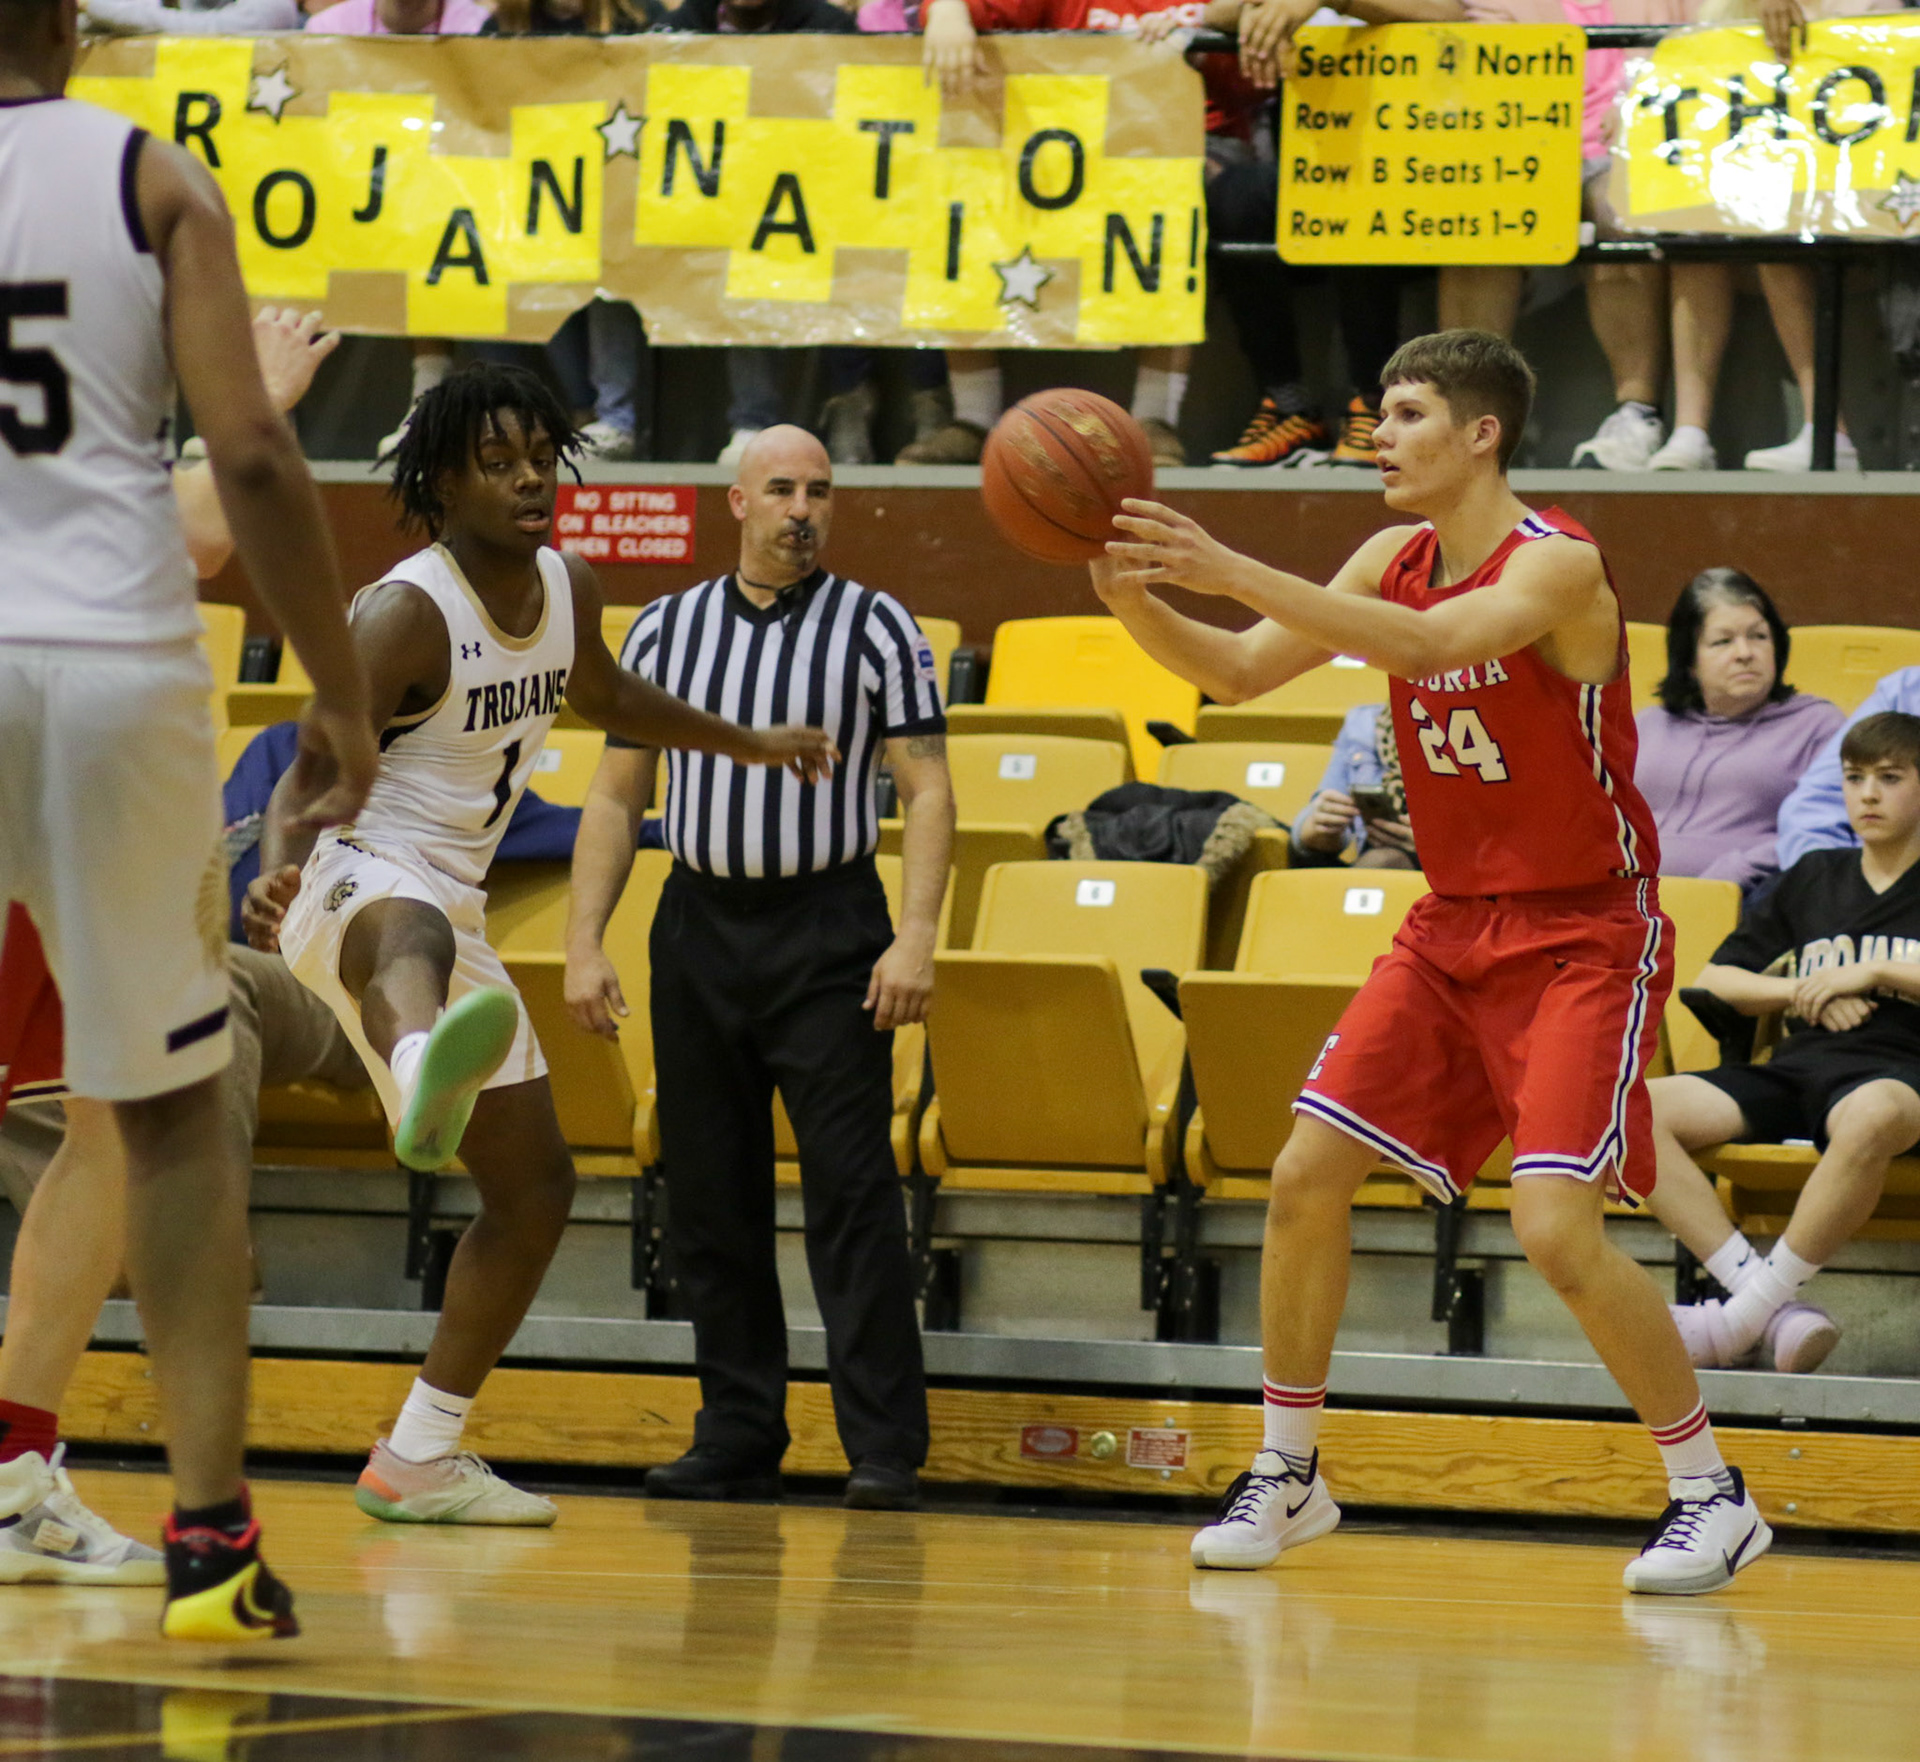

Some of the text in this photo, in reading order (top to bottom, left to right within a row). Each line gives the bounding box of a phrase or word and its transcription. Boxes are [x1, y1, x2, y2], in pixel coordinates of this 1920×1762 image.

[1296, 41, 1575, 77] Section 4 North
[1295, 103, 1353, 131] Row
[1375, 103, 1392, 130] C
[1405, 103, 1484, 131] Seats
[1640, 64, 1920, 166] THO
[1292, 155, 1539, 184] Row B Seats 1-9
[660, 118, 1199, 295] NATION!
[1290, 209, 1537, 237] Row A Seats 1-9
[573, 490, 601, 512] NO
[463, 668, 567, 732] TROJANS
[1408, 695, 1511, 784] 24
[483, 738, 523, 829] 1
